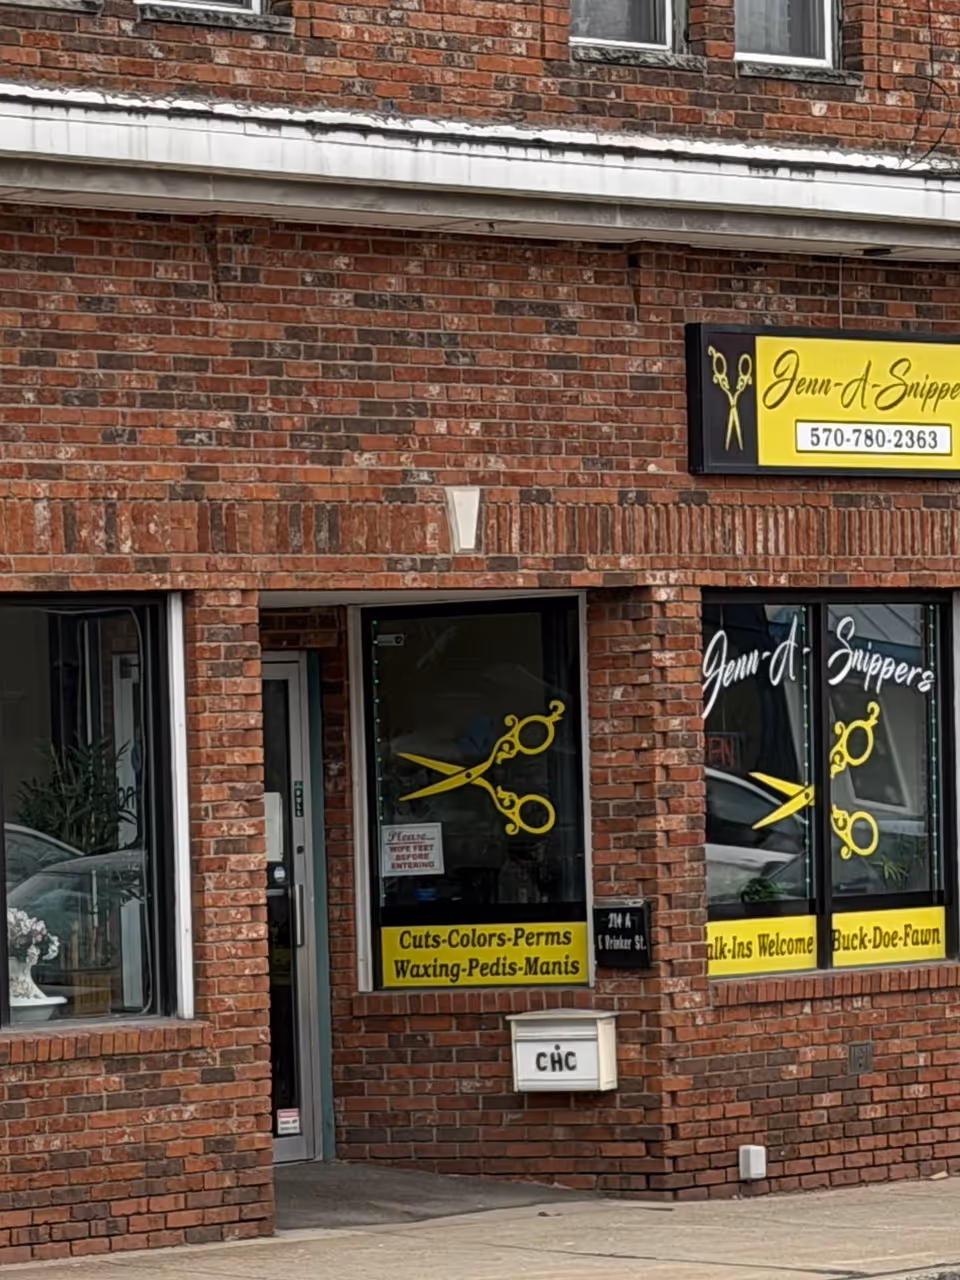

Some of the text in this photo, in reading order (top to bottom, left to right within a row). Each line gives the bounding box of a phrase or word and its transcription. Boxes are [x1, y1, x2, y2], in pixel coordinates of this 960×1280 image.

[810, 427, 938, 449] 570-780-2363
[827, 616, 935, 693] Snippers
[399, 927, 572, 949] Cuts-Colors-Perms
[634, 934, 647, 950] St.
[705, 923, 942, 961] alk-Ins Welcome Buck-Doe-Fawn
[394, 955, 580, 983] Waxing-Pedis-Manis
[535, 1050, 577, 1072] CHC
